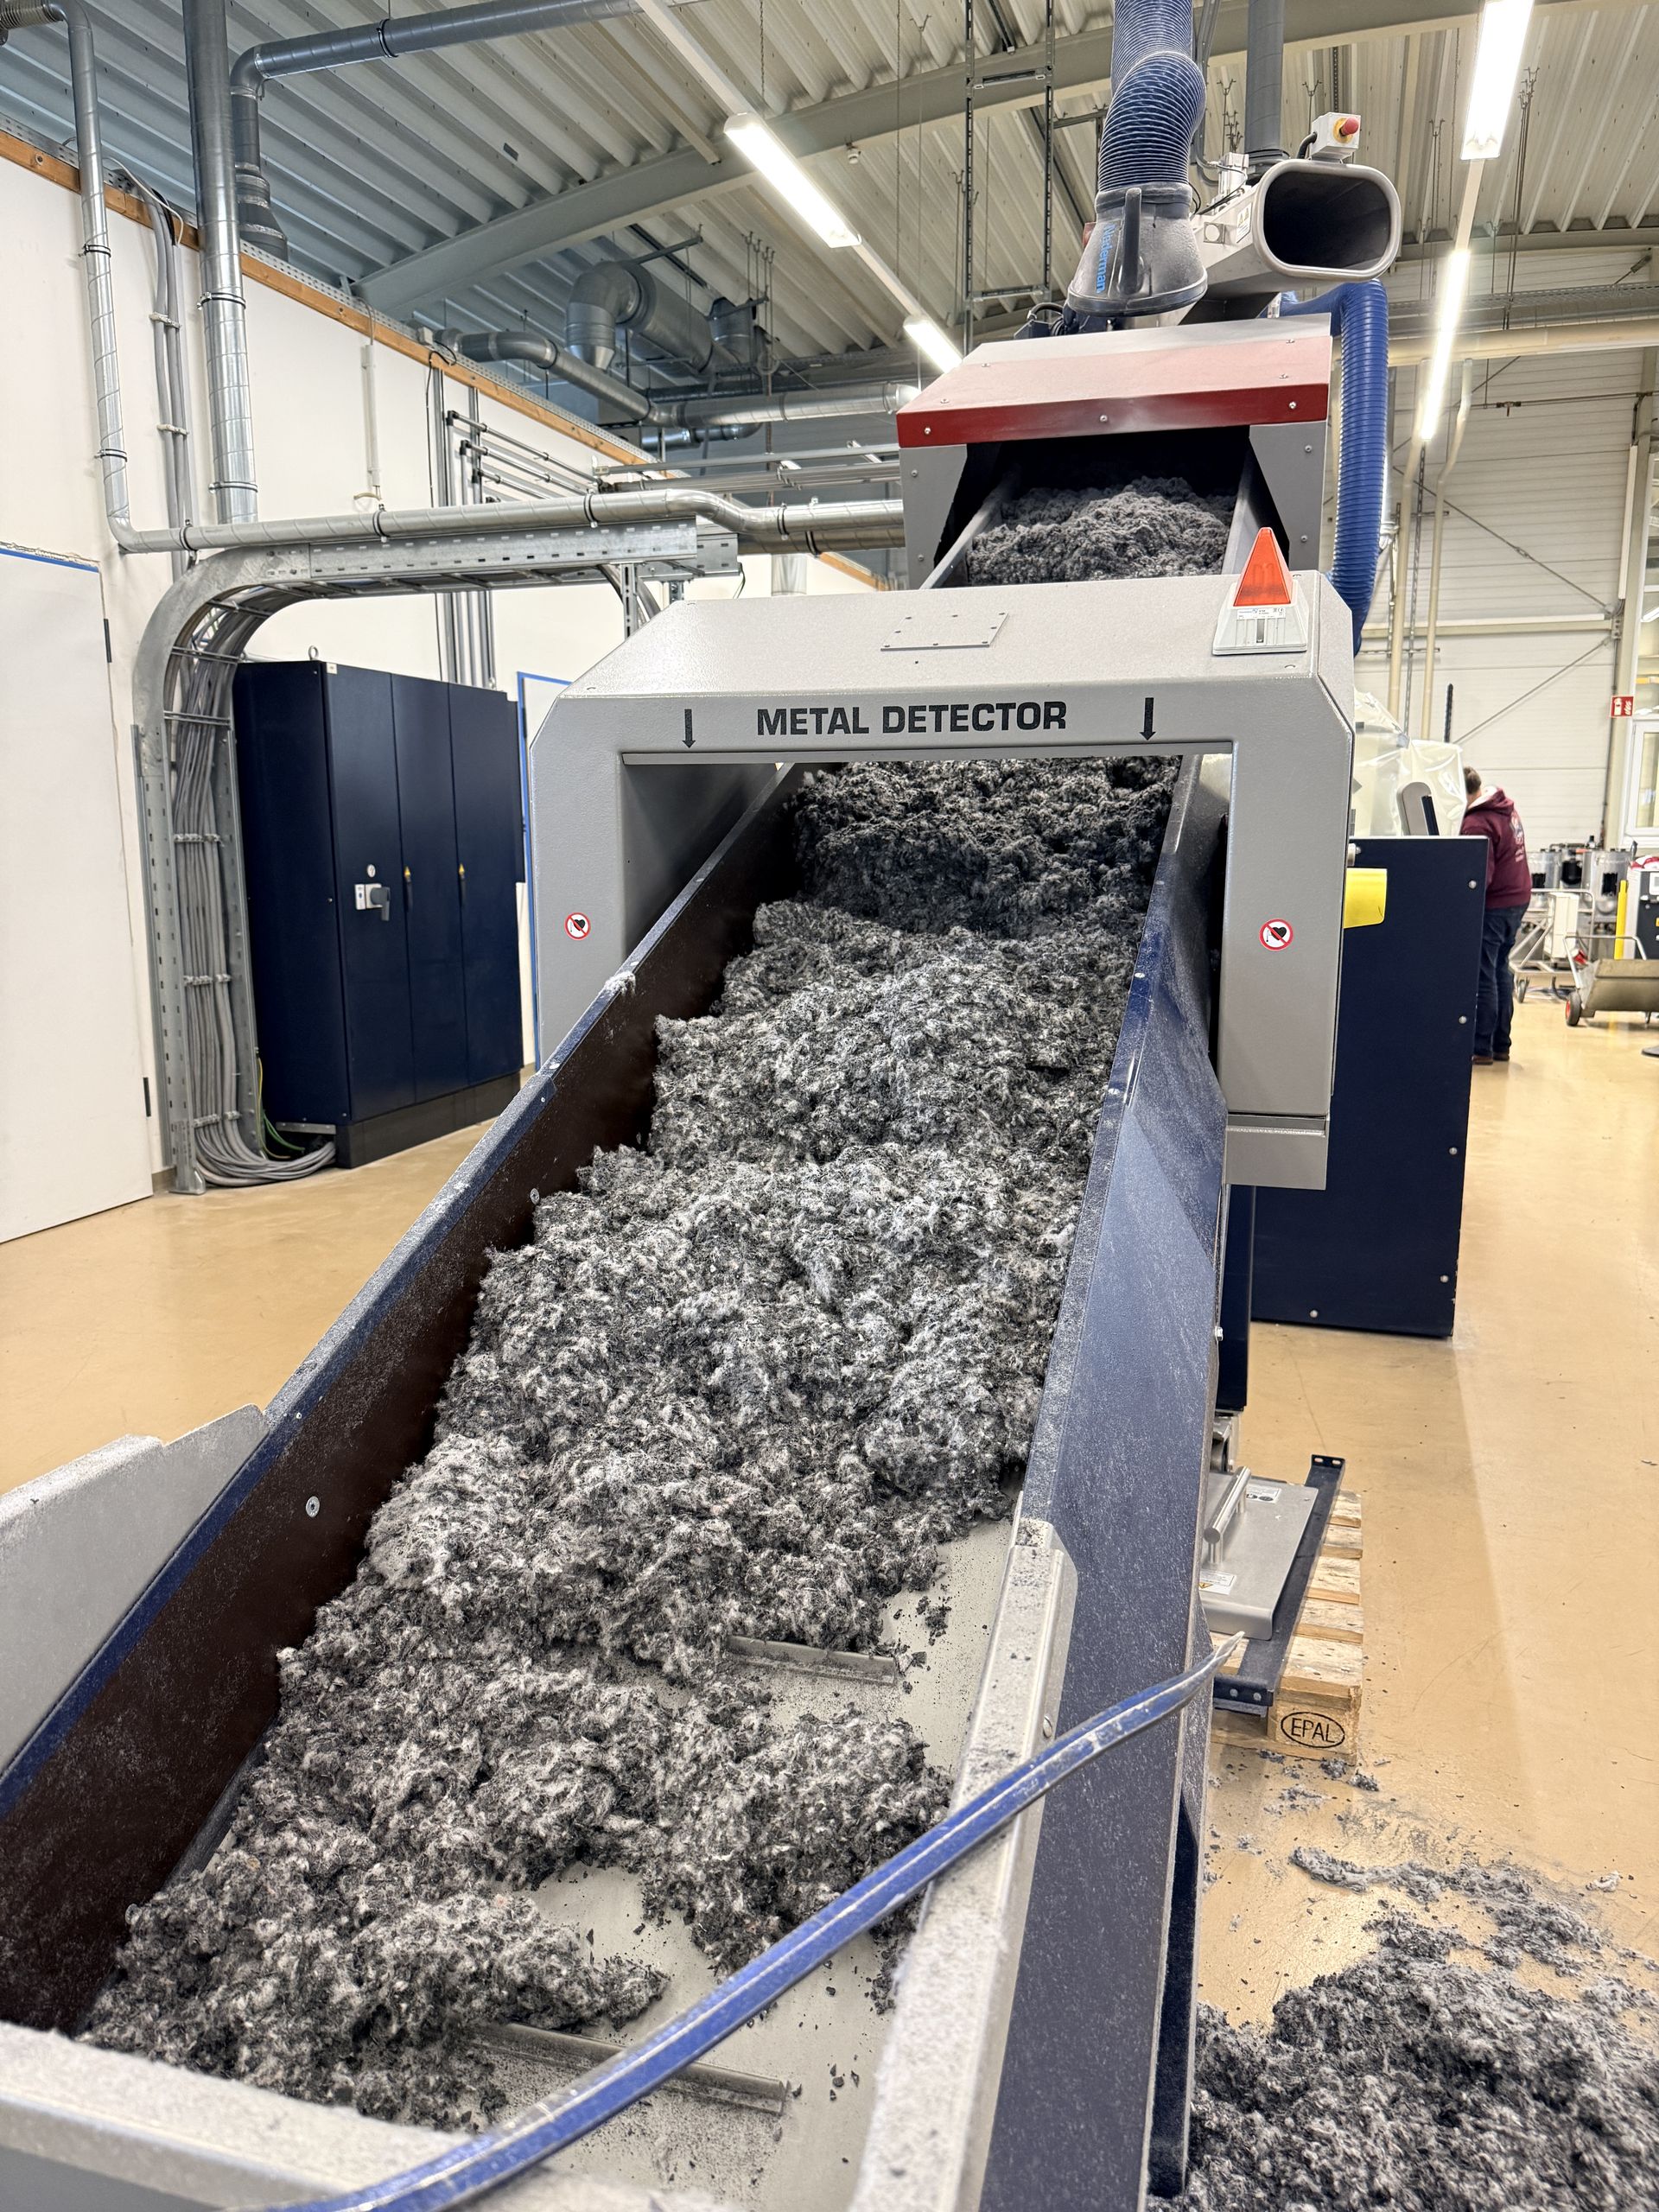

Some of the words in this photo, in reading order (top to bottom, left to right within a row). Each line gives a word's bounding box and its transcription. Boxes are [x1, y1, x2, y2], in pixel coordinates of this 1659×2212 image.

[1096, 223, 1117, 294] Nederman
[757, 707, 869, 736] METAL
[882, 701, 1067, 734] DETECTOR
[1291, 1717, 1336, 1744] EPAL
